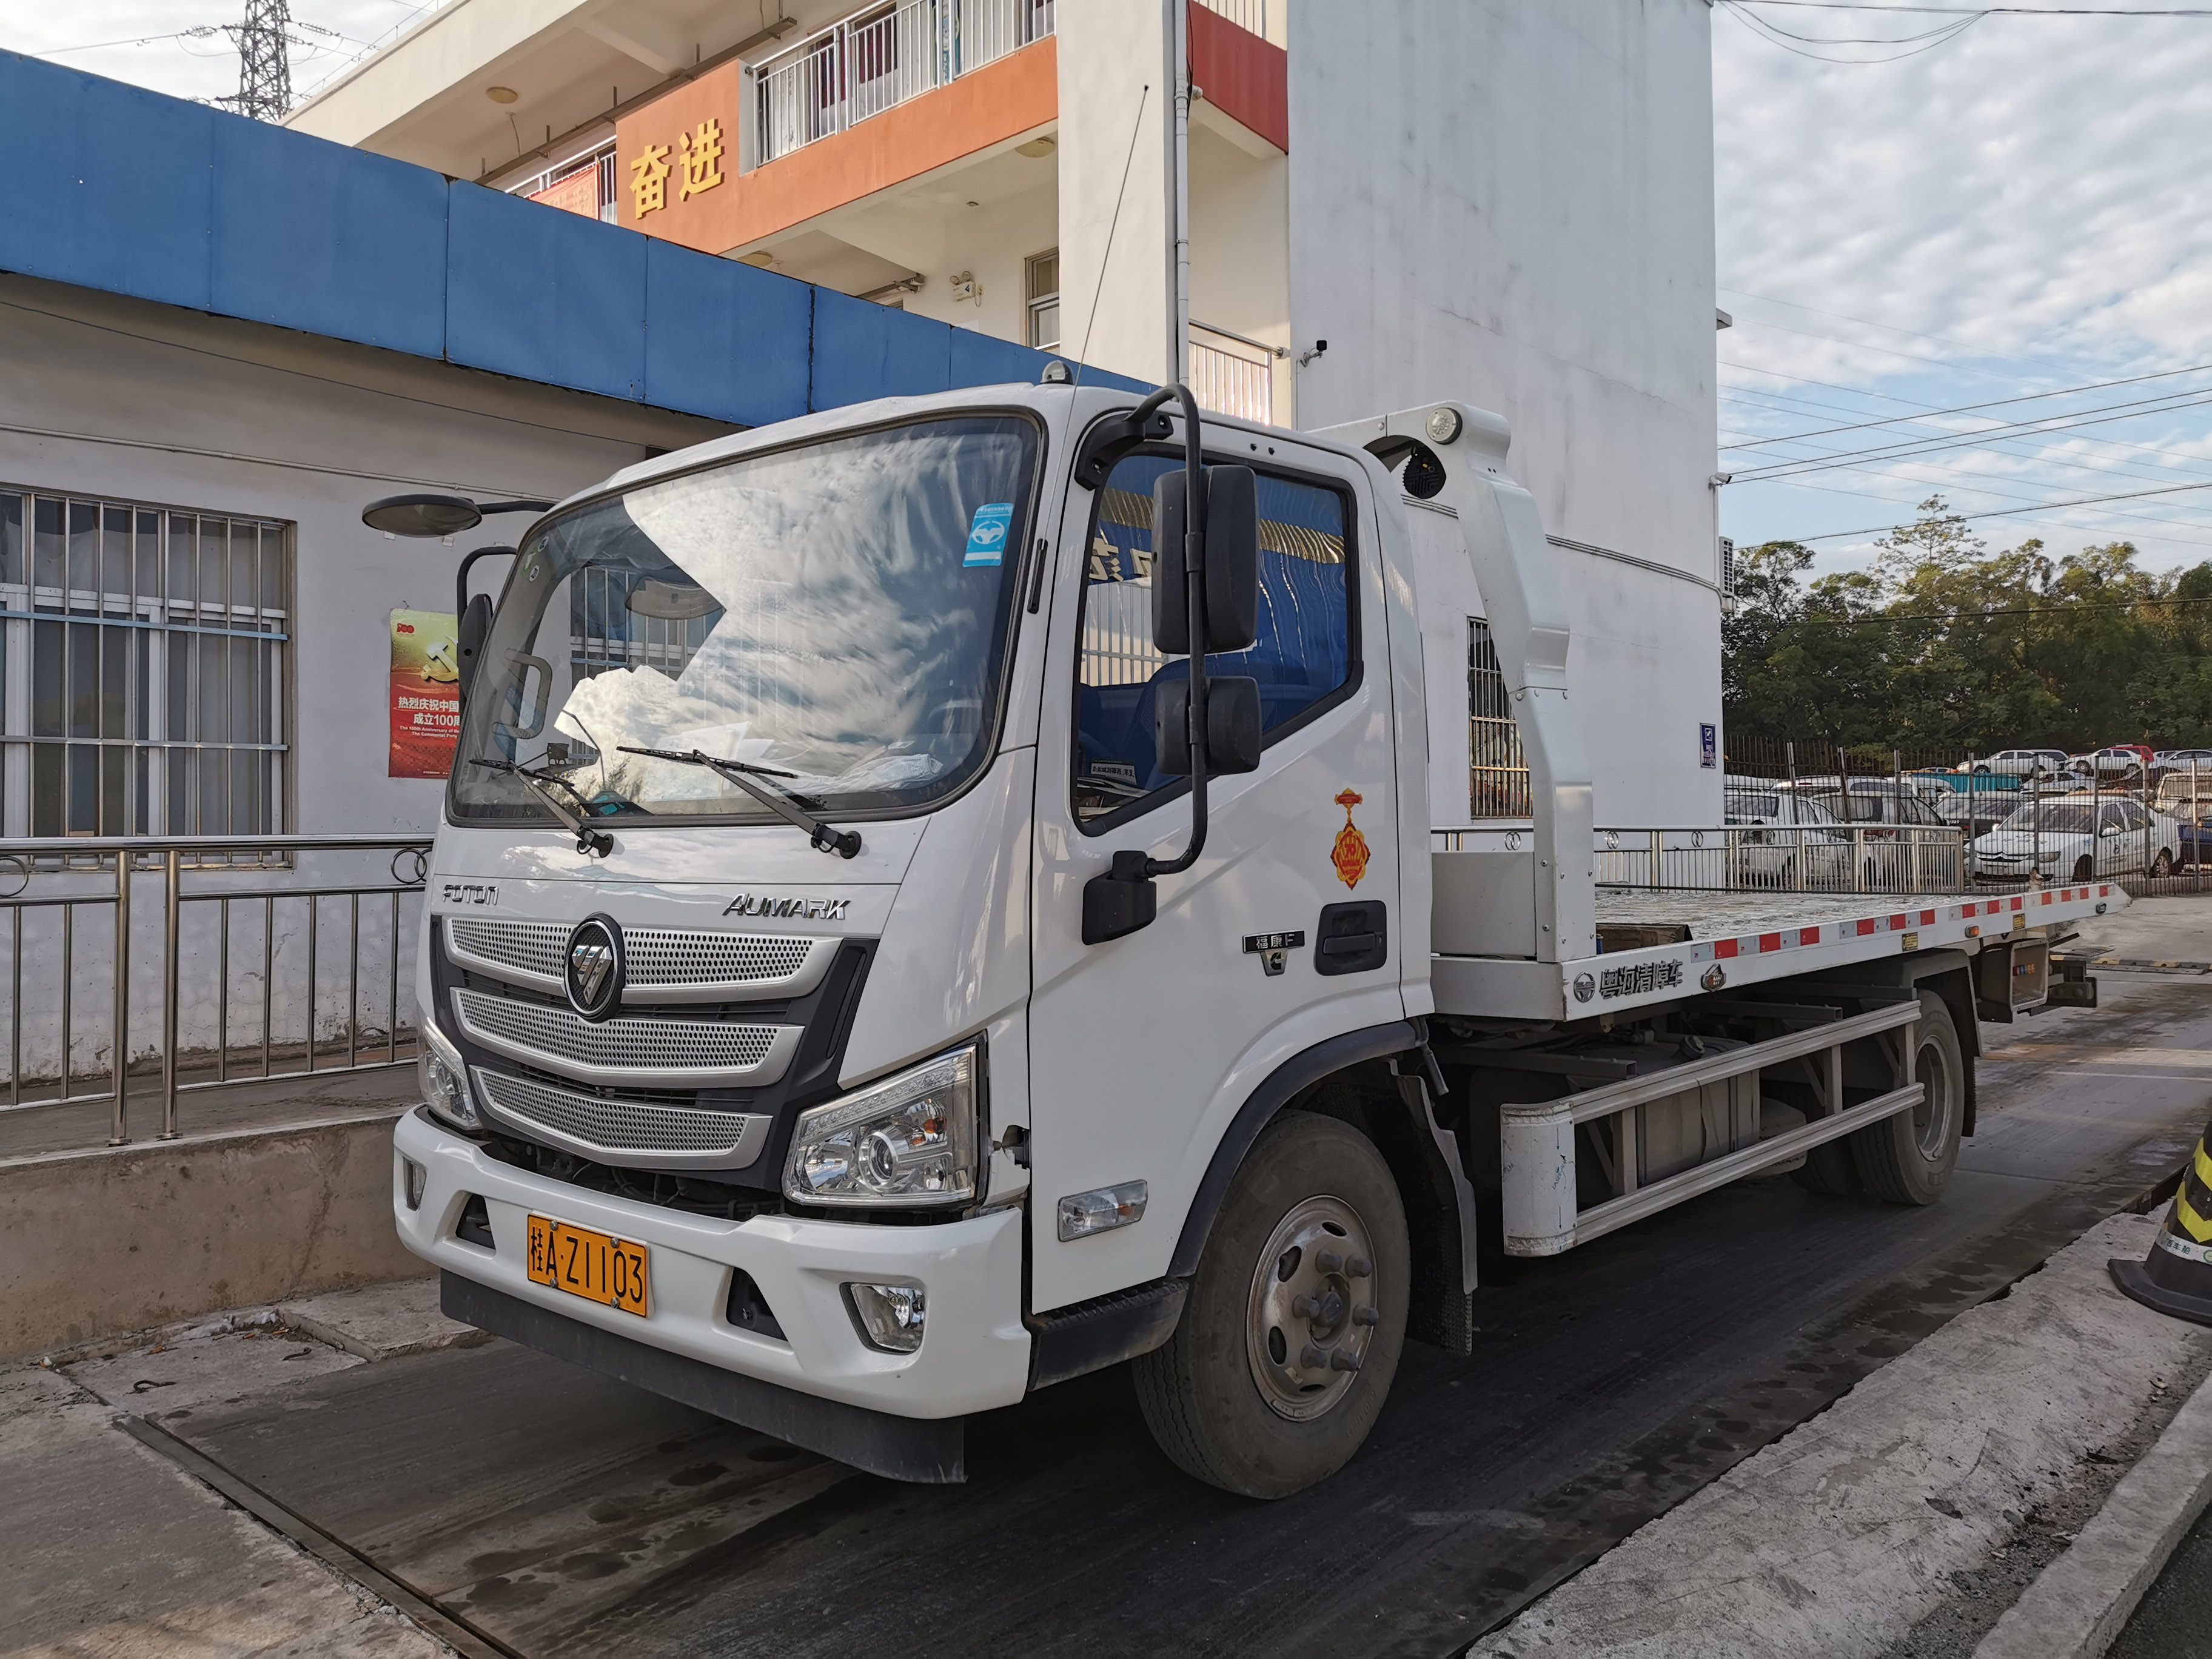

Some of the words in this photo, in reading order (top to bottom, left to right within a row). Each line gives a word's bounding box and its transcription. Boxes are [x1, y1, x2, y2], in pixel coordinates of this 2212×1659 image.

[629, 118, 725, 220] 奋进
[398, 696, 460, 712] 热烈庆祝中国
[442, 884, 499, 905] FOTON
[722, 893, 851, 920] AUMARK
